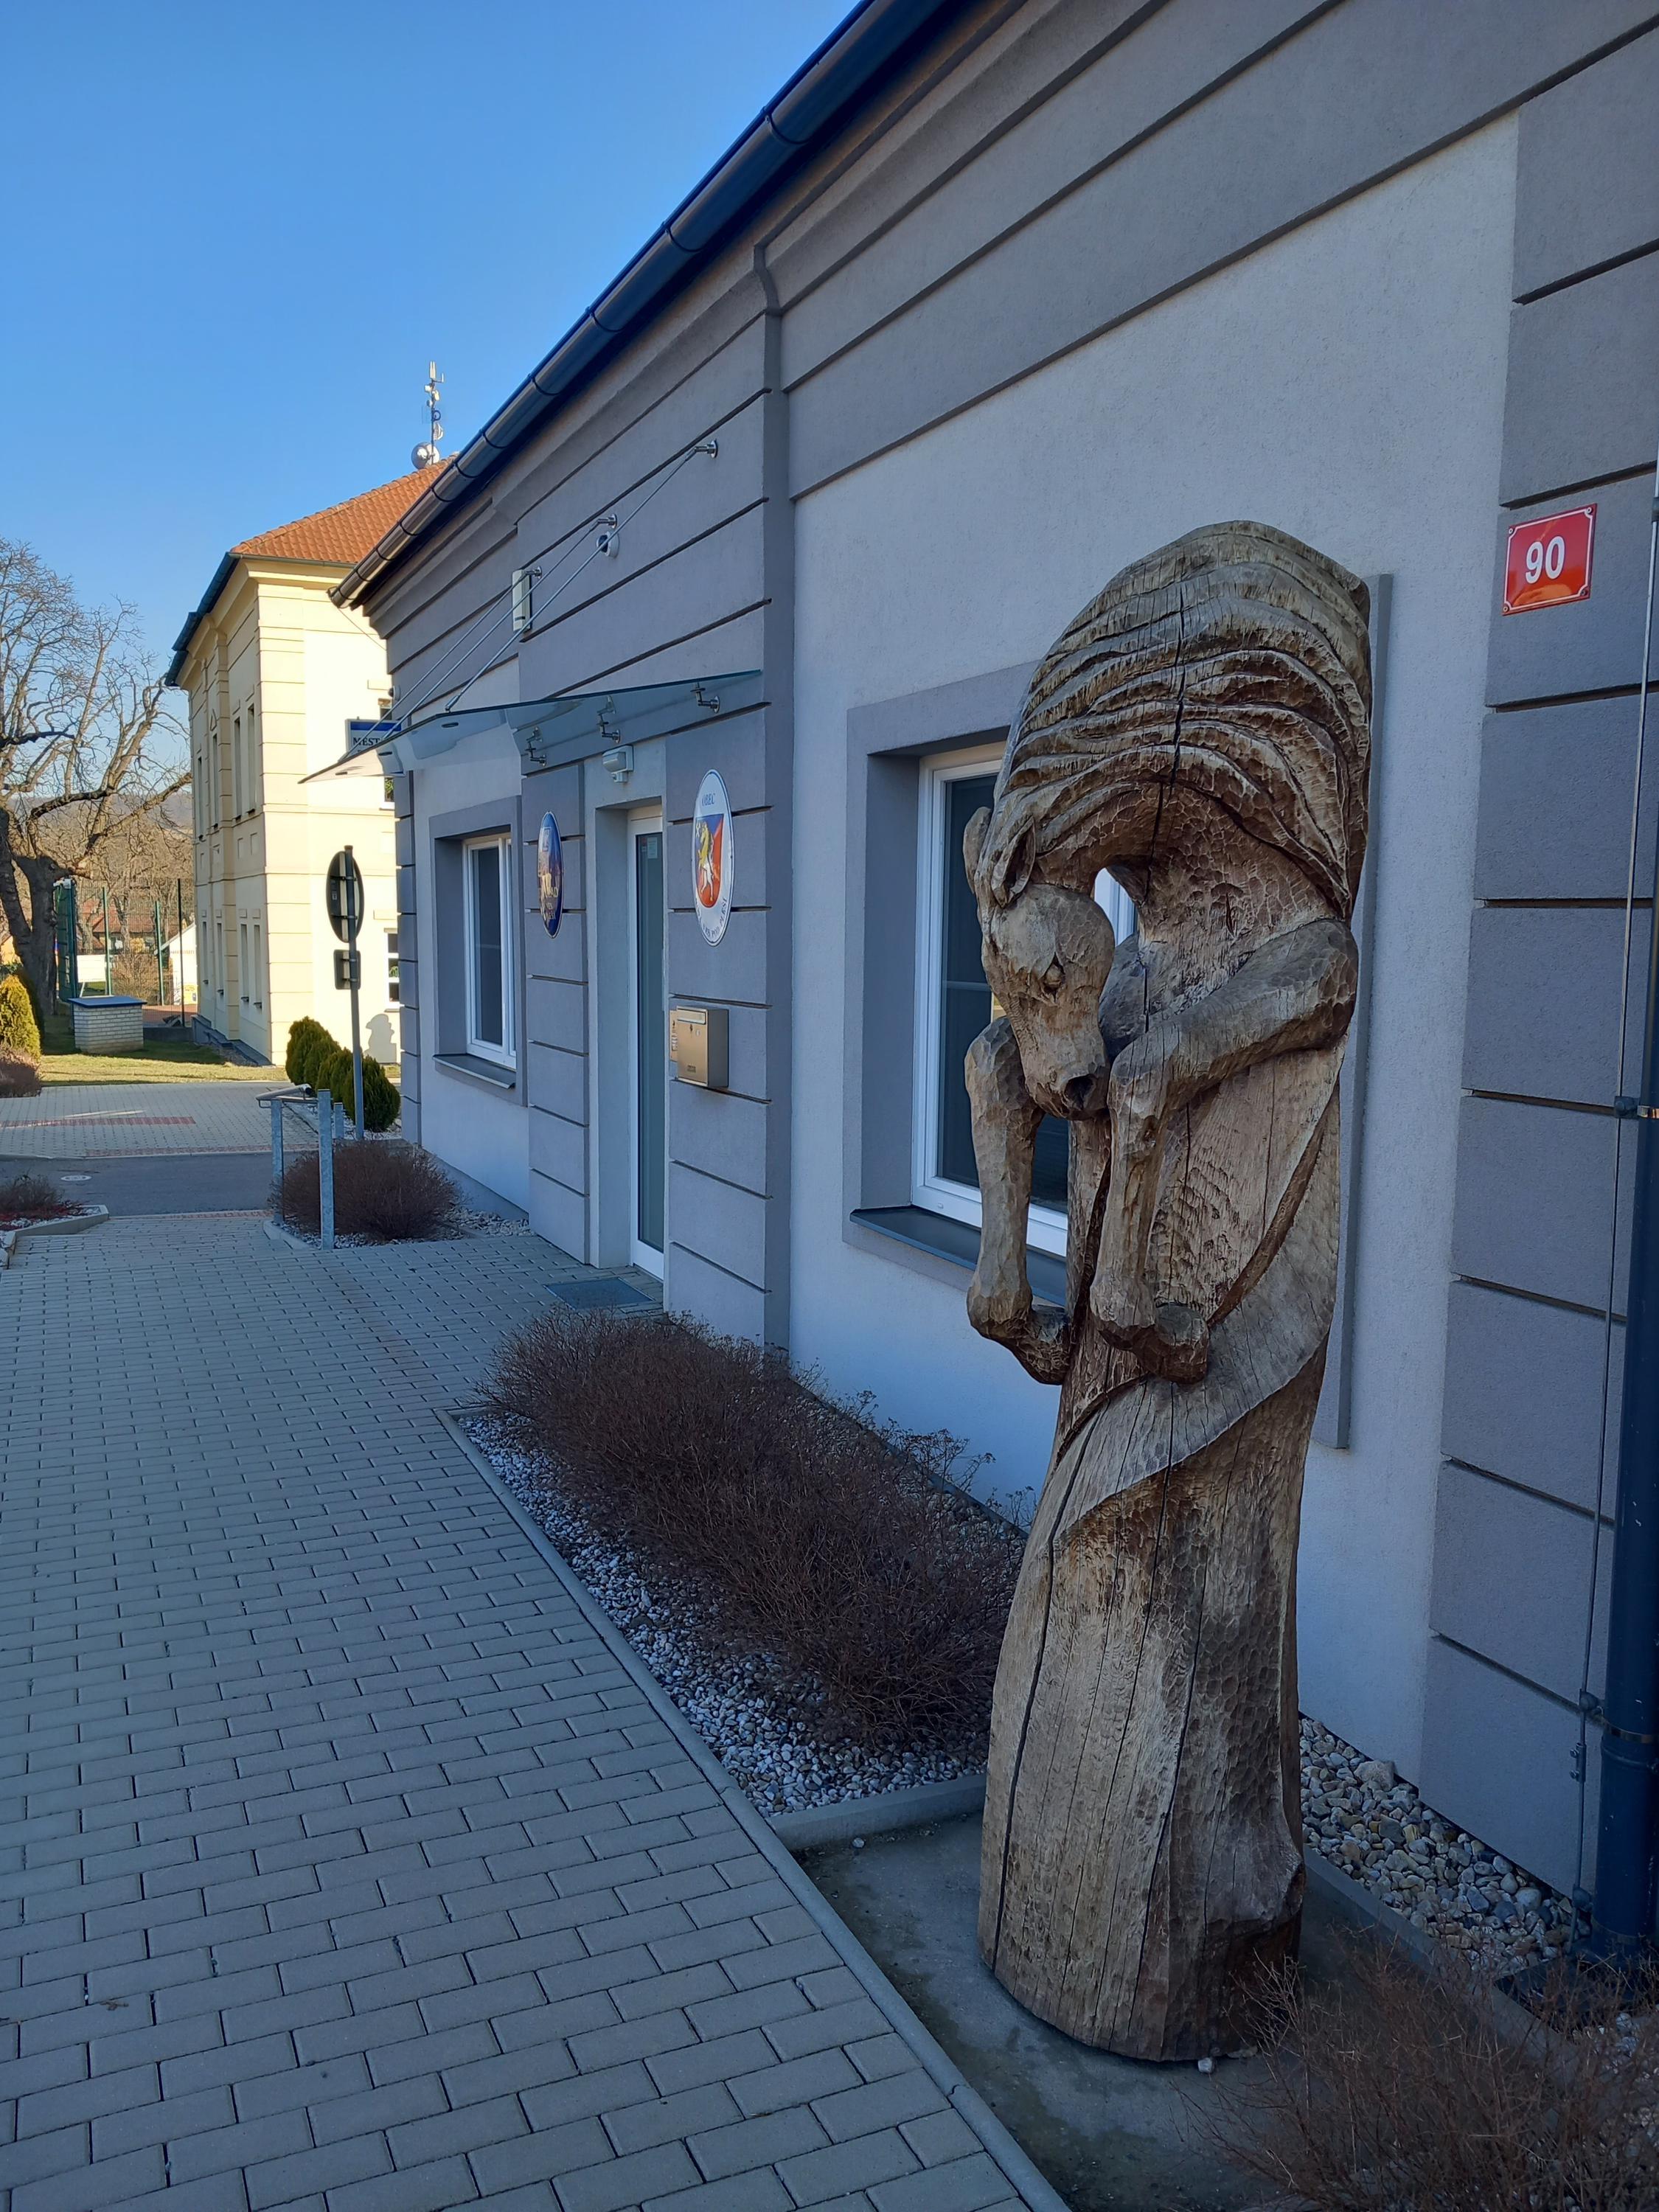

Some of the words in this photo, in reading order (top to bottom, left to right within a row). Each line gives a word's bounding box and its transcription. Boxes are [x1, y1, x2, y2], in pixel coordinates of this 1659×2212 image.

[1525, 535, 1565, 584] 90
[353, 737, 381, 746] MEST
[701, 793, 716, 807] OBEC
